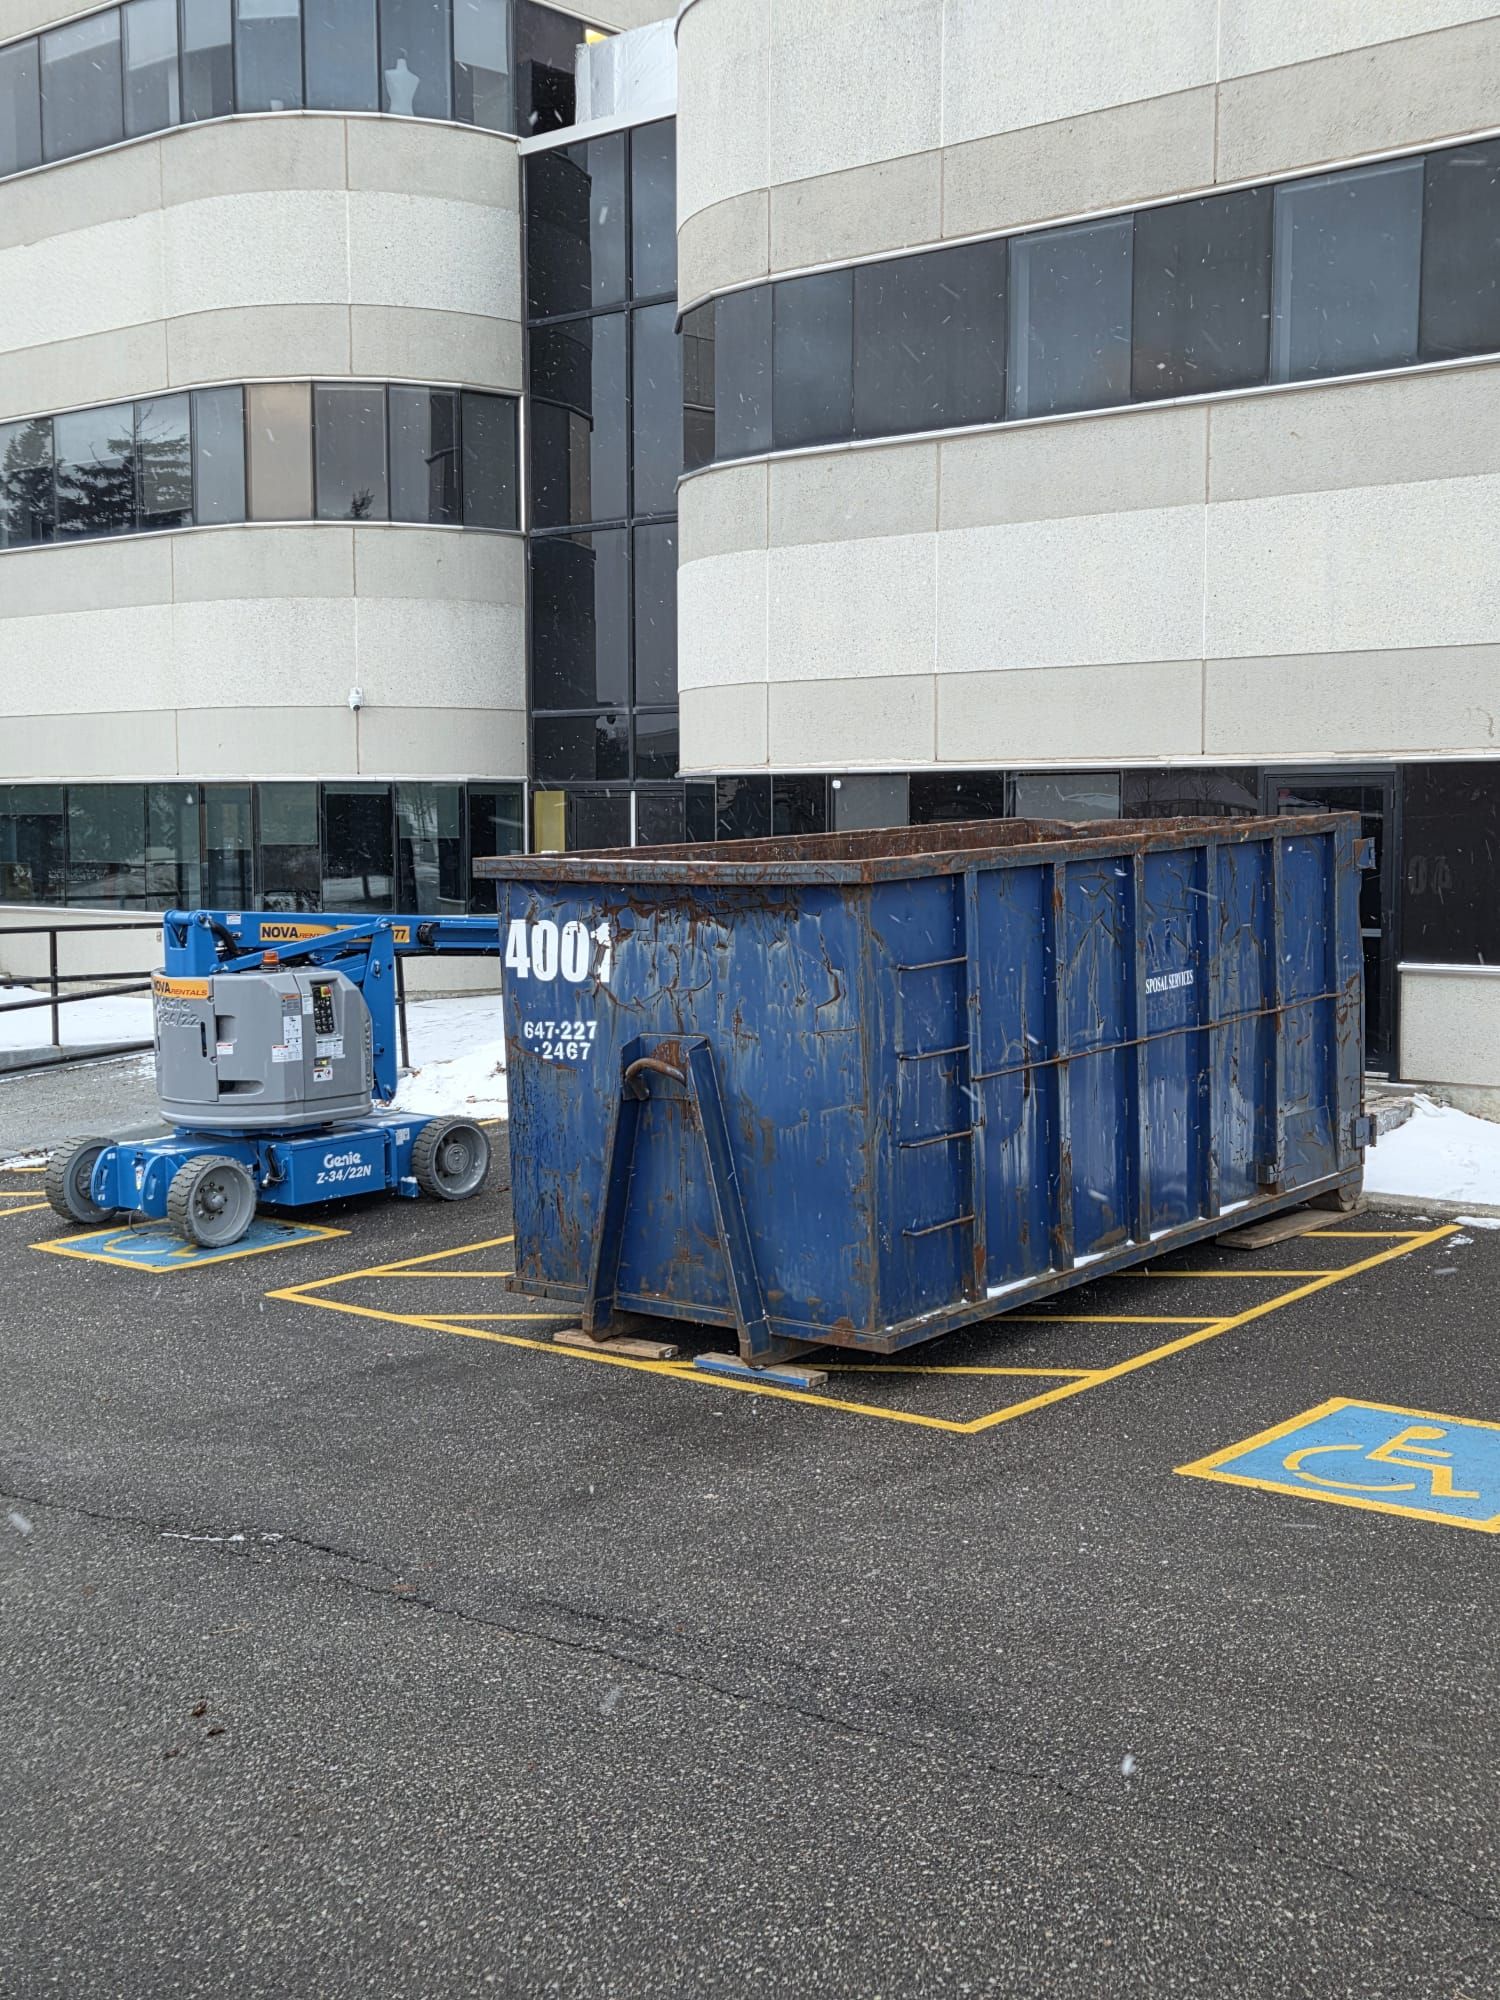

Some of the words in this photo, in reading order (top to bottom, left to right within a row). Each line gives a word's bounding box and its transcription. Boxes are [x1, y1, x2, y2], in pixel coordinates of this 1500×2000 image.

[261, 926, 299, 939] NOVA
[505, 919, 612, 983] 4001
[1145, 975, 1169, 994] SPOSAL
[1168, 969, 1194, 990] SERVICES
[170, 988, 208, 996] RENTALS
[323, 1151, 362, 1169] Genie
[316, 1164, 372, 1185] Z-34/22N
